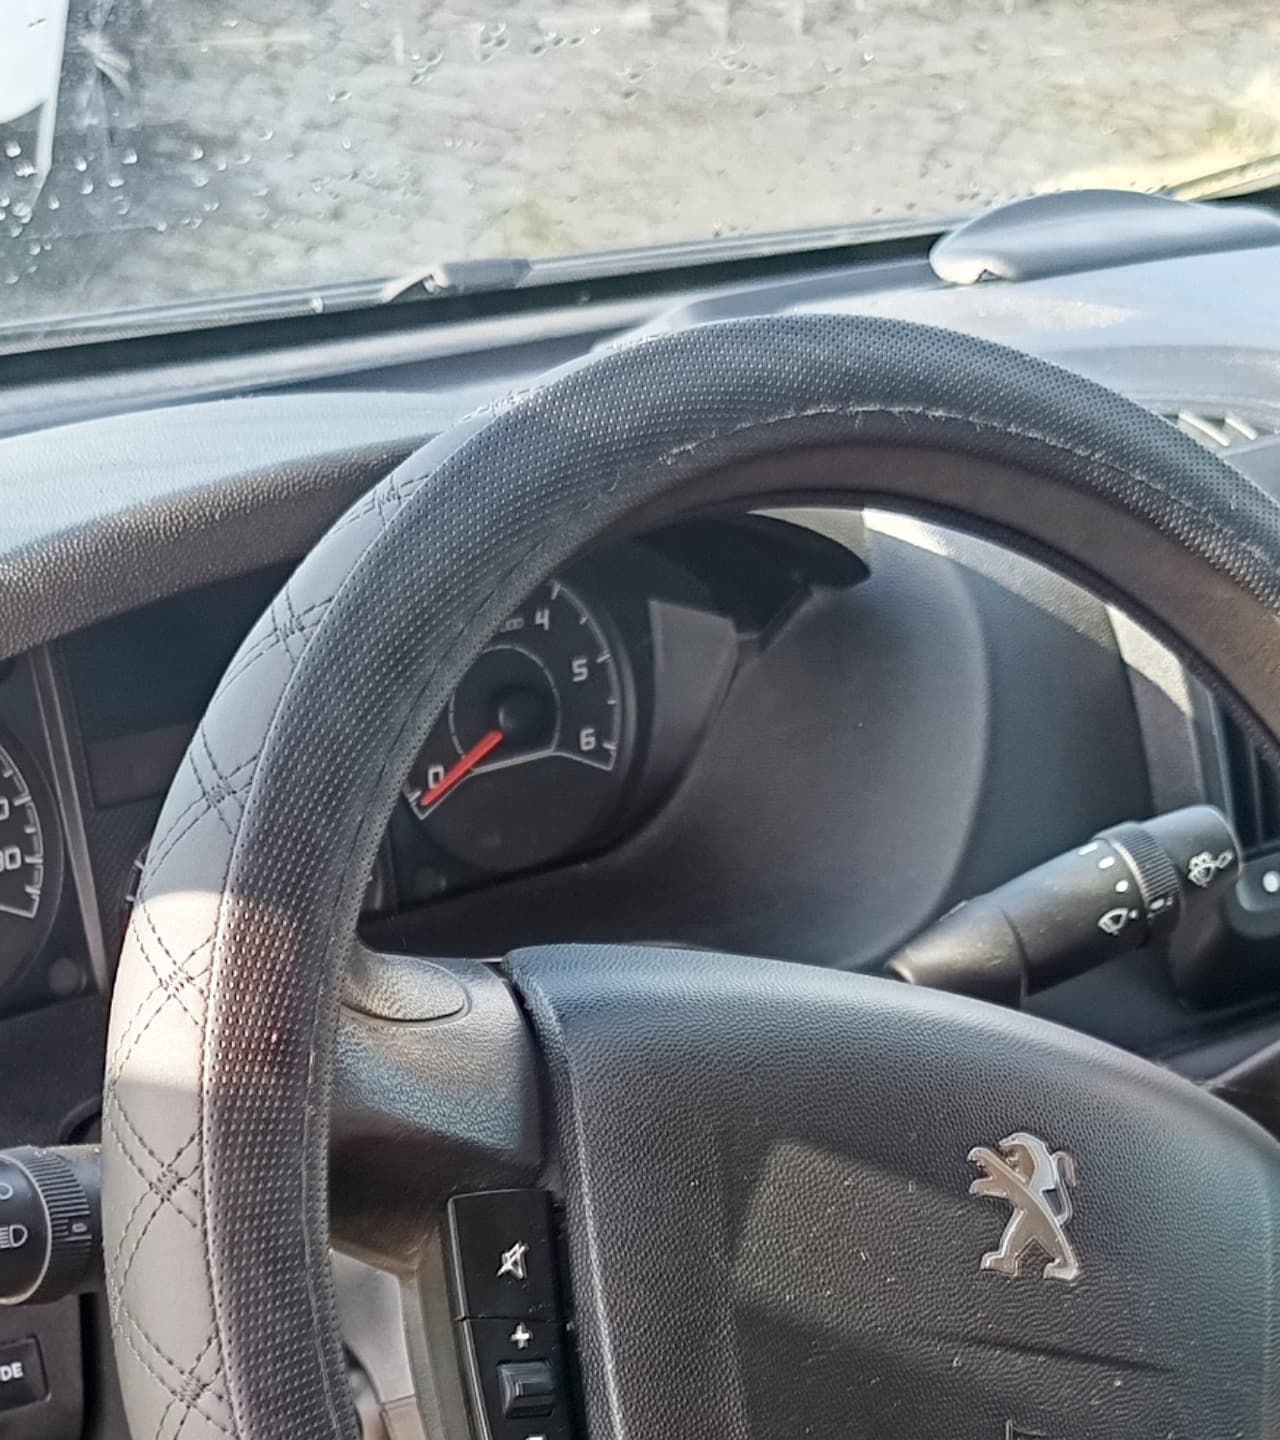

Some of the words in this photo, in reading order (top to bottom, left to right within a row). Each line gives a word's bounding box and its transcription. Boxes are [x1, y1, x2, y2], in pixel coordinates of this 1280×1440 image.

[534, 608, 550, 631] 4
[572, 658, 588, 682] 5
[580, 728, 596, 751] 6
[428, 764, 445, 789] 0
